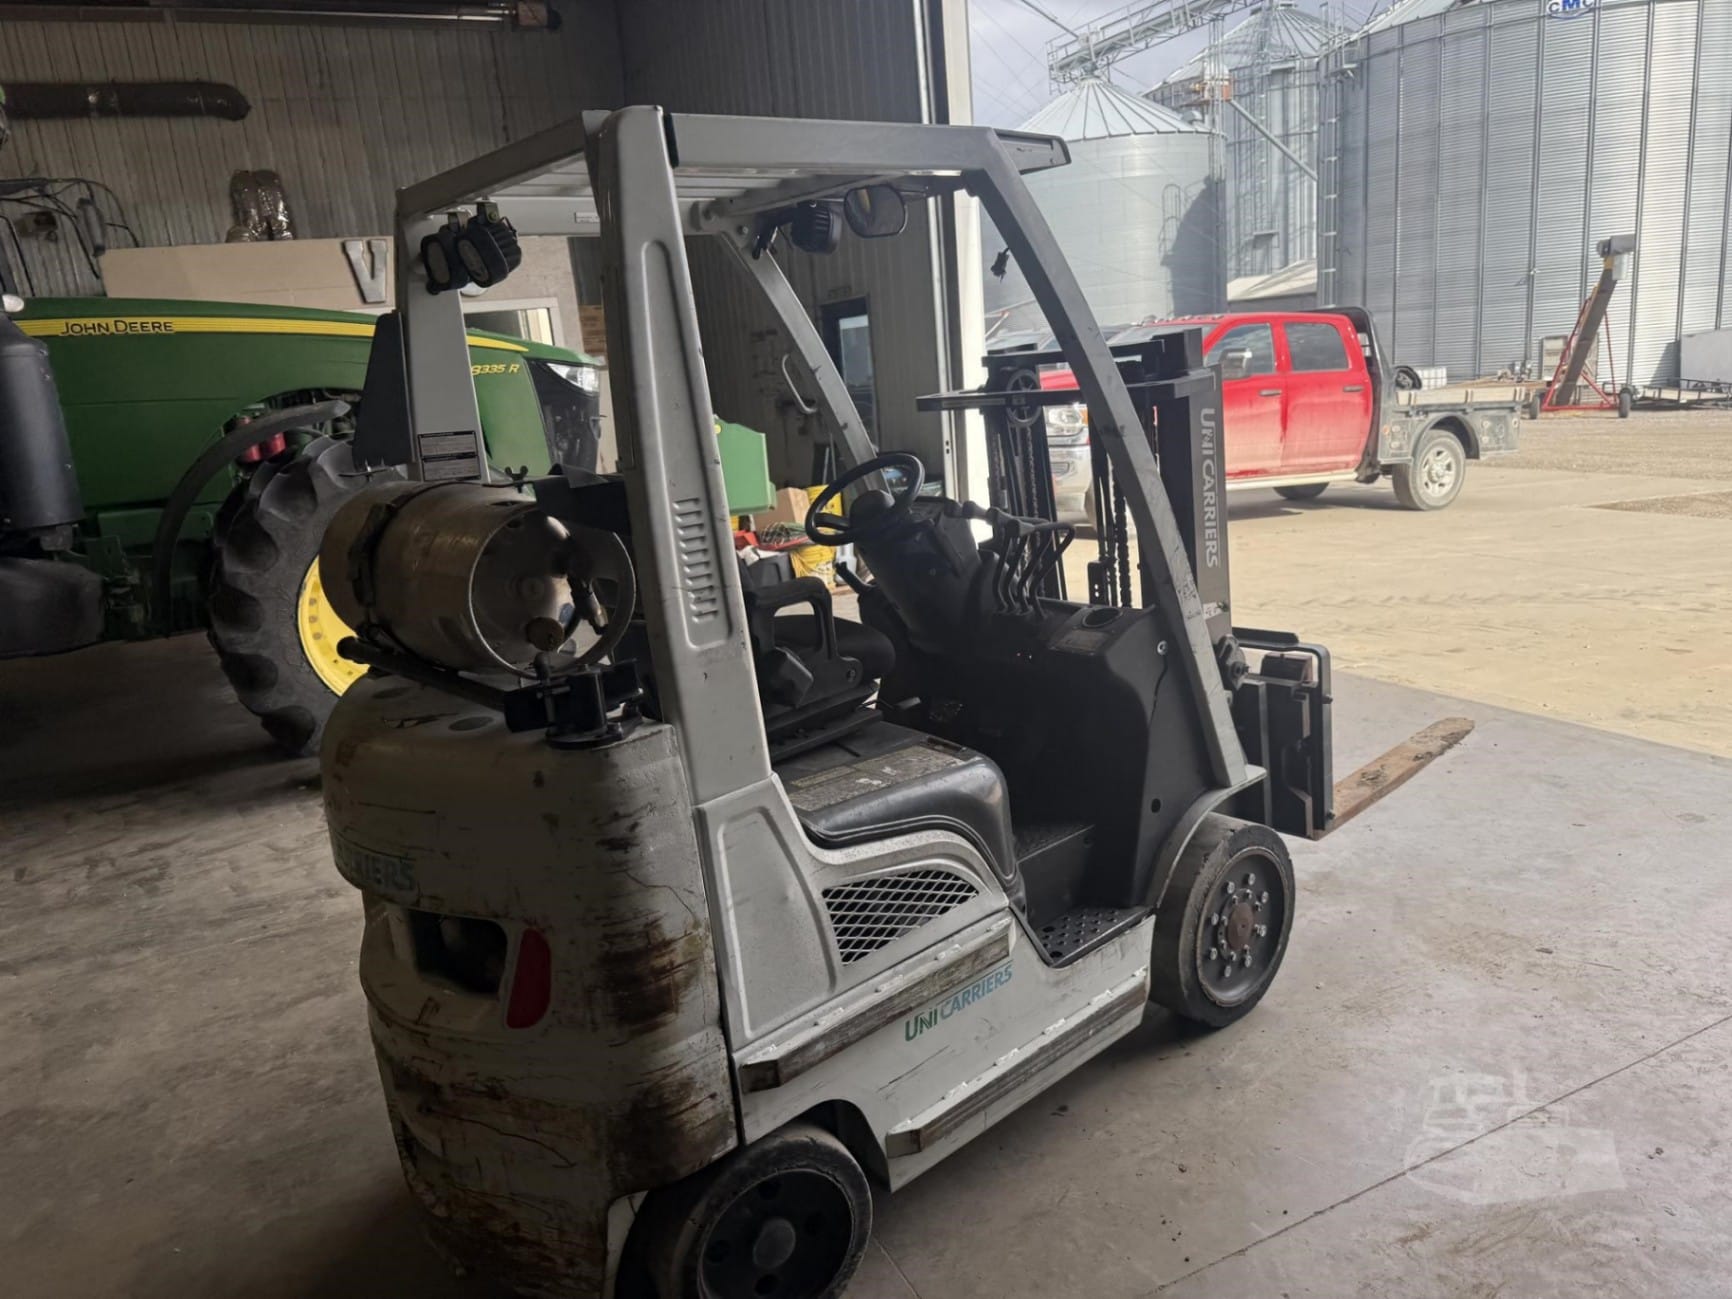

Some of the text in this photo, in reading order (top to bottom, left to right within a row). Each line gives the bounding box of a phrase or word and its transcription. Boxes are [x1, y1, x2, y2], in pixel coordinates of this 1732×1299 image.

[341, 239, 387, 304] V
[61, 320, 173, 335] JOHN DEERE
[508, 363, 520, 374] R
